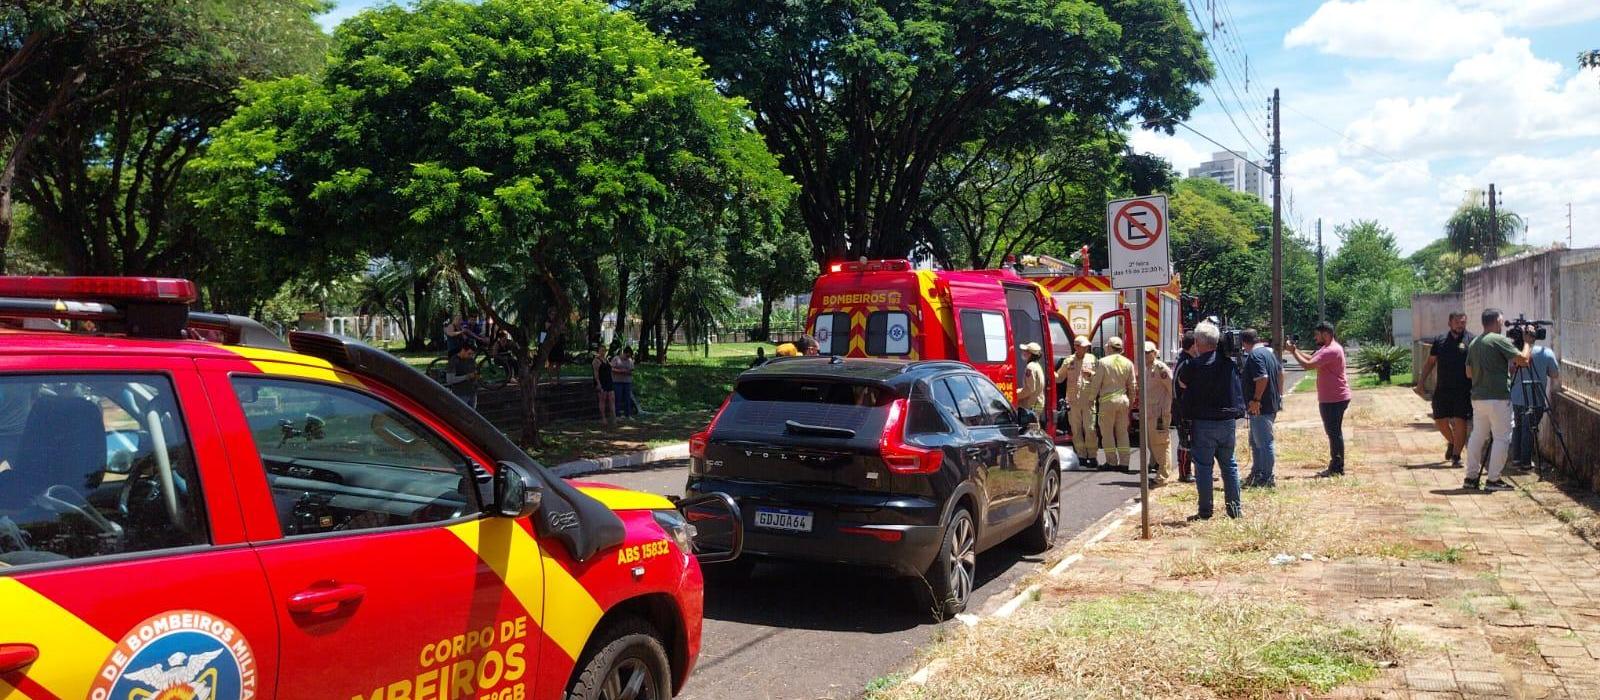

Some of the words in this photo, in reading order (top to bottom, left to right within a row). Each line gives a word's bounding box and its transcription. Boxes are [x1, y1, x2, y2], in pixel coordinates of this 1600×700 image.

[822, 293, 886, 306] BOMBEIROS
[1072, 322, 1087, 330] 193
[745, 450, 826, 462] VOLVO
[617, 545, 641, 566] ABS
[641, 539, 670, 560] 15832
[419, 626, 495, 668] CORPO
[500, 616, 527, 644] DE
[102, 650, 128, 682] DE
[125, 613, 234, 651] BOMBEIROS
[231, 640, 256, 700] MILITA
